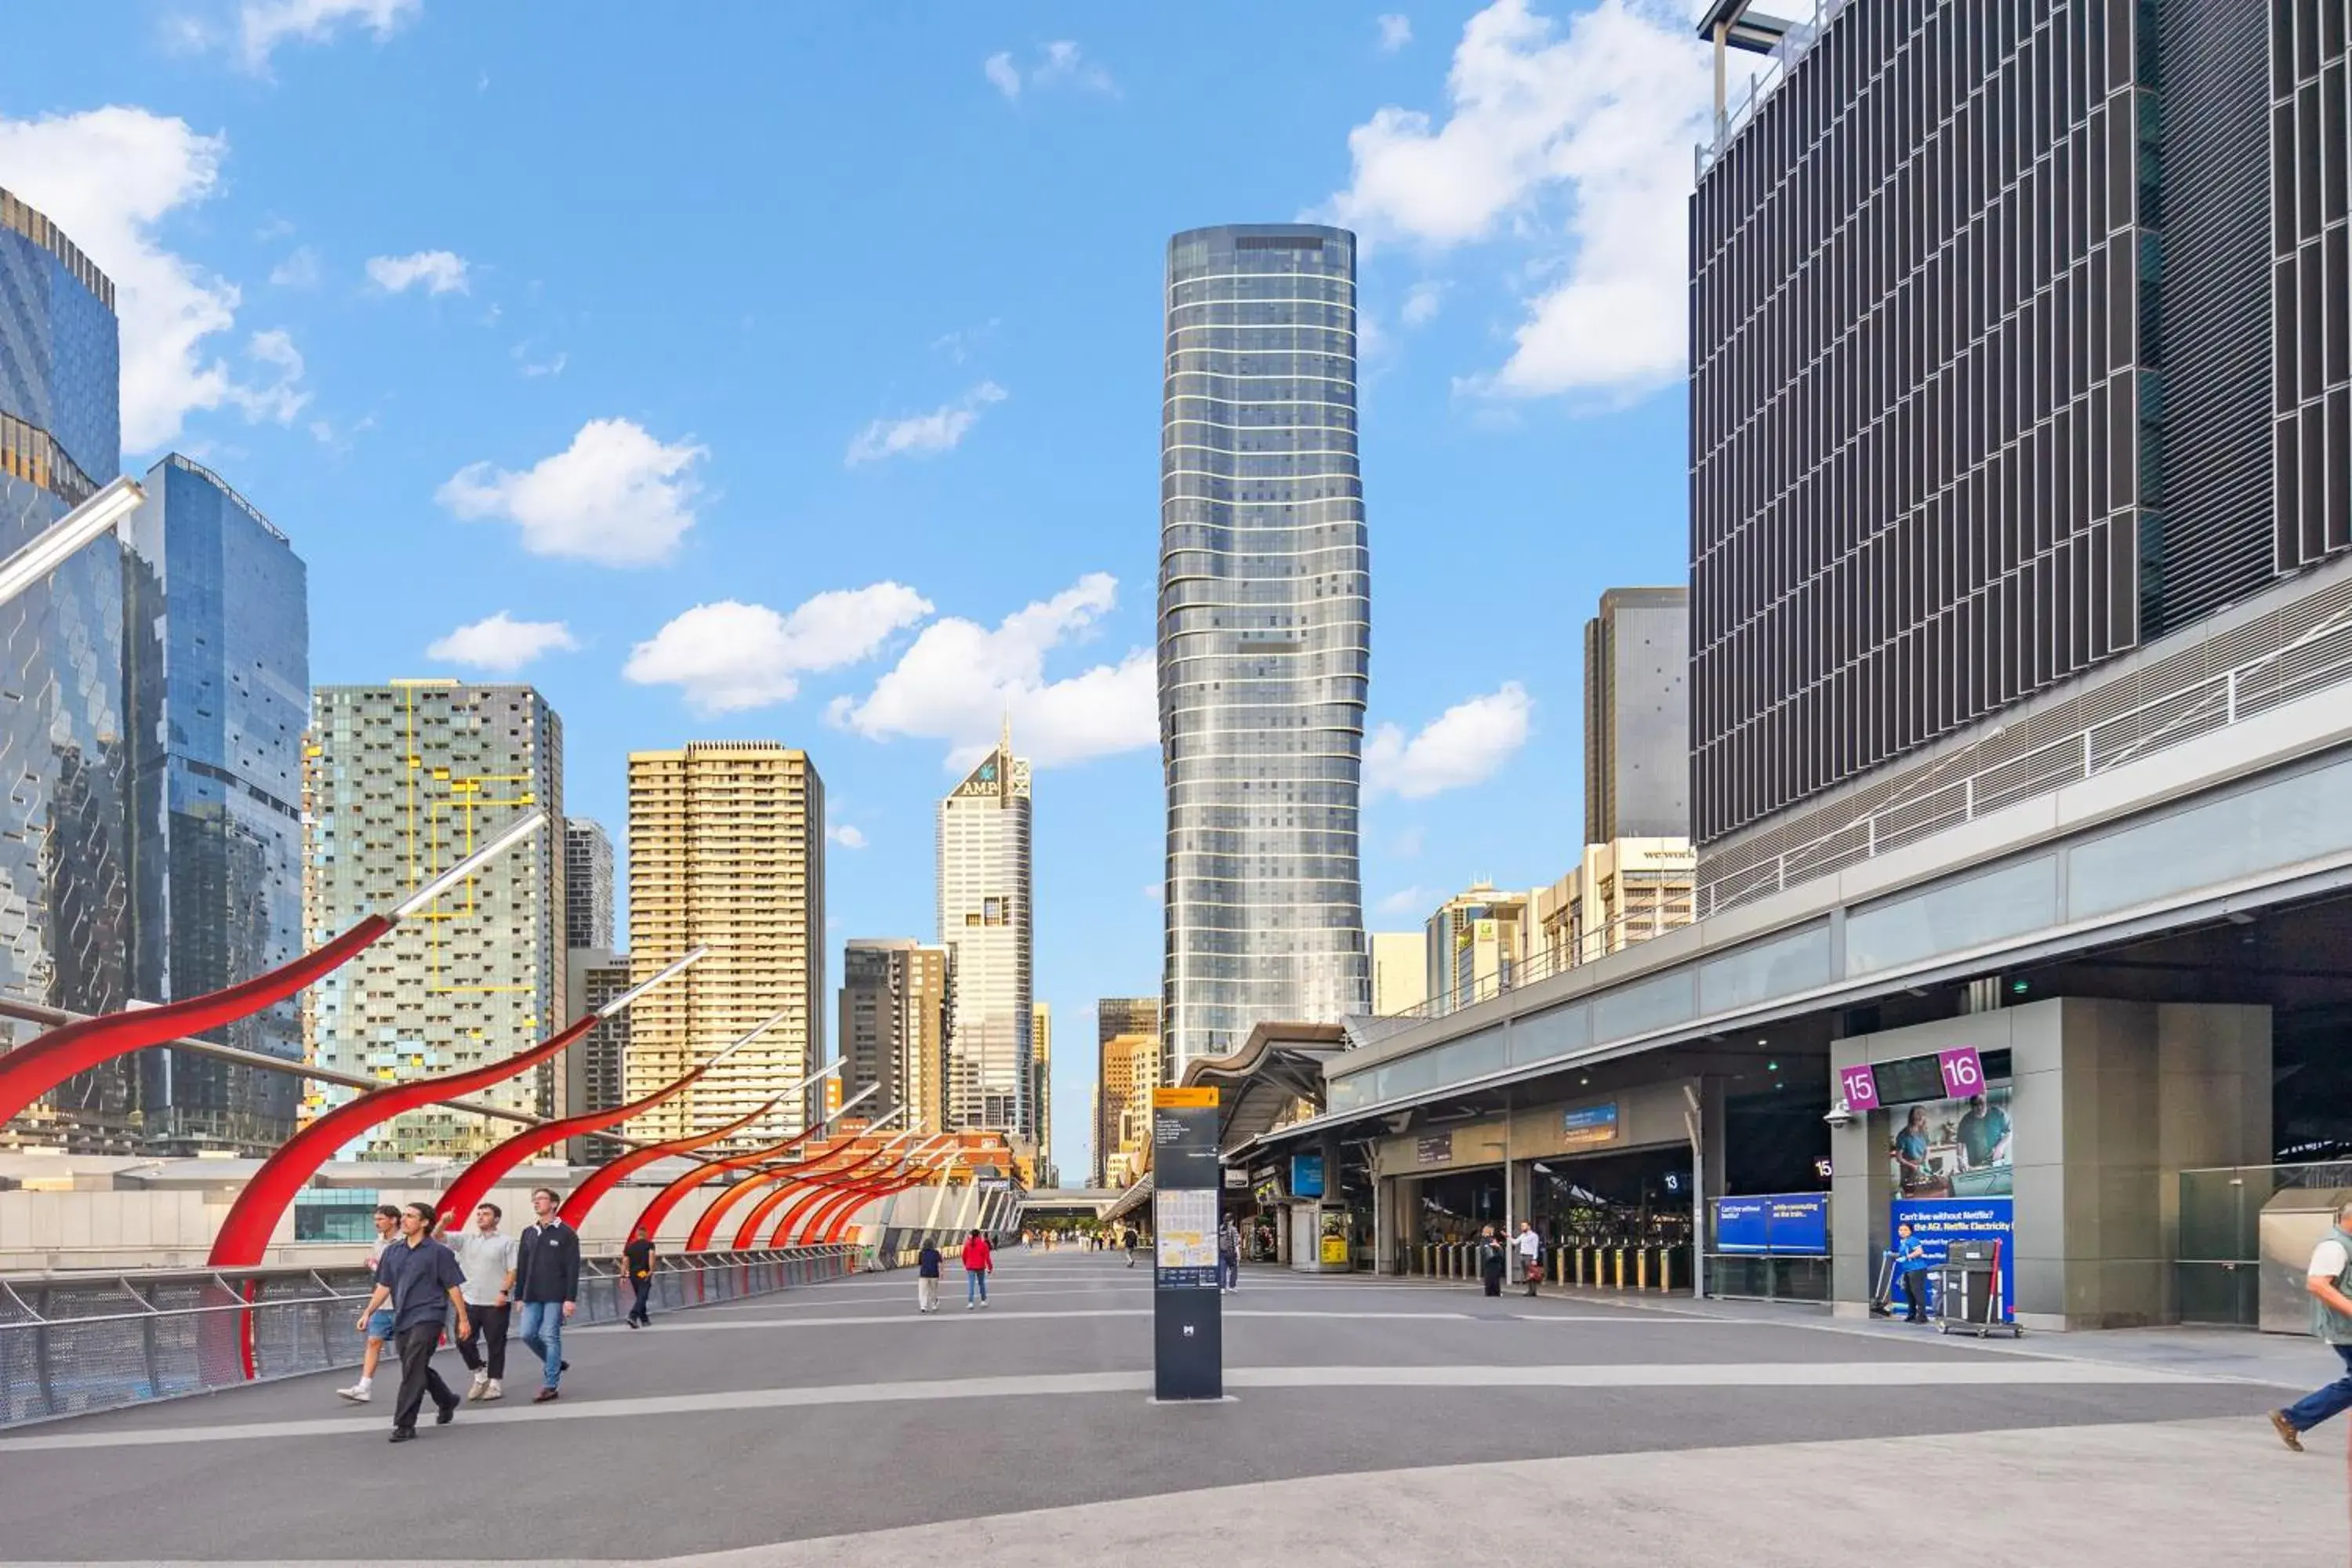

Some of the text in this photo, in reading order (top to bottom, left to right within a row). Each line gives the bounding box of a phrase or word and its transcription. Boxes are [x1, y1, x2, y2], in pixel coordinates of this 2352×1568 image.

[962, 781, 998, 795] AMP
[1944, 1057, 1977, 1086] 16
[1843, 1074, 1872, 1100] 15
[1815, 1160, 1831, 1176] 15
[1665, 1175, 1678, 1189] 13
[1933, 1211, 1962, 1221] without
[1963, 1210, 1994, 1220] Netflix?
[1914, 1222, 1926, 1232] the
[1944, 1221, 1969, 1231] Netflix
[1970, 1221, 2010, 1232] Electricity
